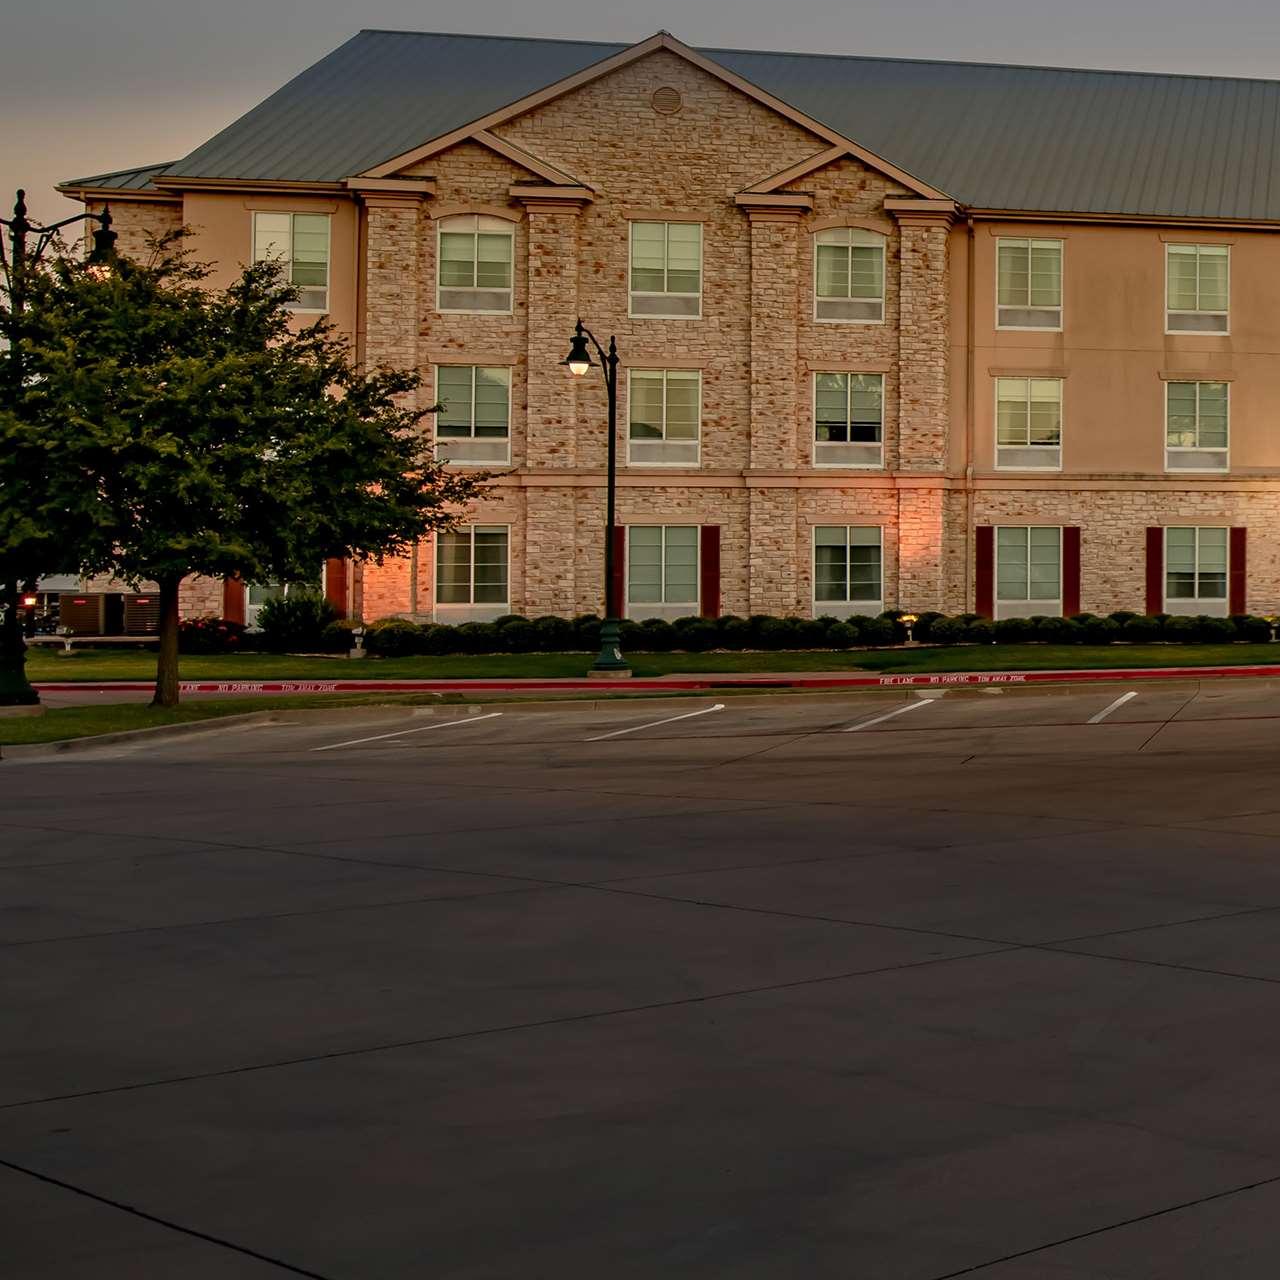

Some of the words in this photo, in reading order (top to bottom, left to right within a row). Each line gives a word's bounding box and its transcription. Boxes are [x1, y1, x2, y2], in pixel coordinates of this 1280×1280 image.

[897, 677, 915, 685] LANE
[942, 675, 969, 683] PARKING
[217, 683, 228, 692] NO
[230, 683, 264, 692] PARKING
